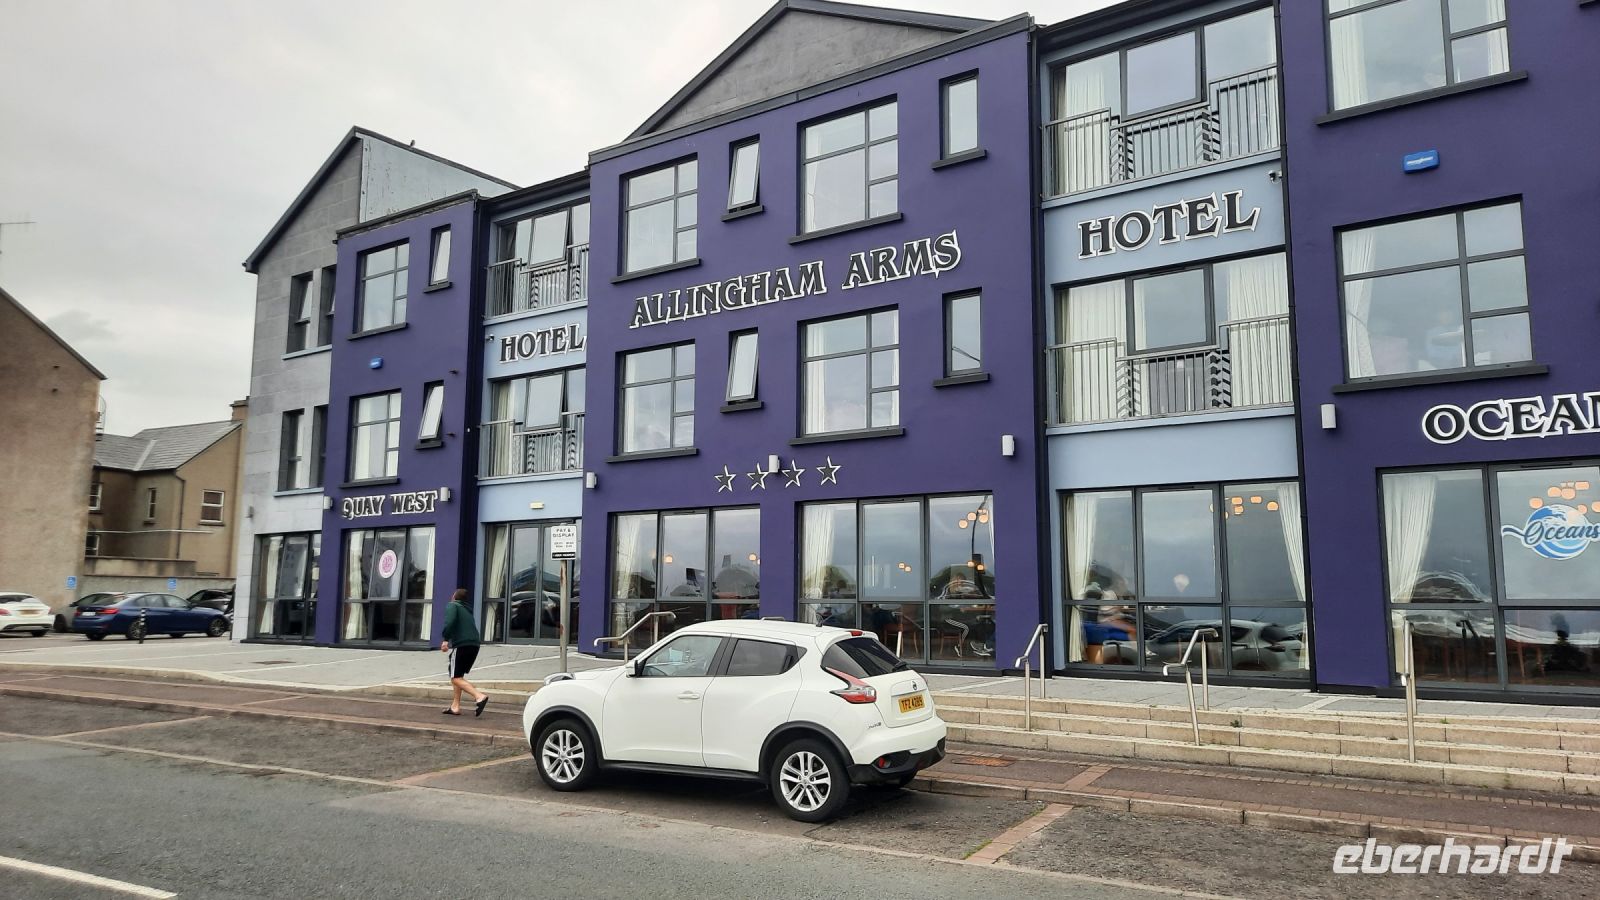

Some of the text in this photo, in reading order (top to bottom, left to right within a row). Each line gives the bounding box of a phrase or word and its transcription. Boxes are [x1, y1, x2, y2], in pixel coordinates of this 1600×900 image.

[1078, 189, 1261, 260] HOTEL
[629, 229, 962, 329] ALLINGHAM ARMS
[499, 323, 587, 364] HOTEL
[342, 490, 438, 520] QUAY WEST
[1502, 520, 1600, 546] Oceans
